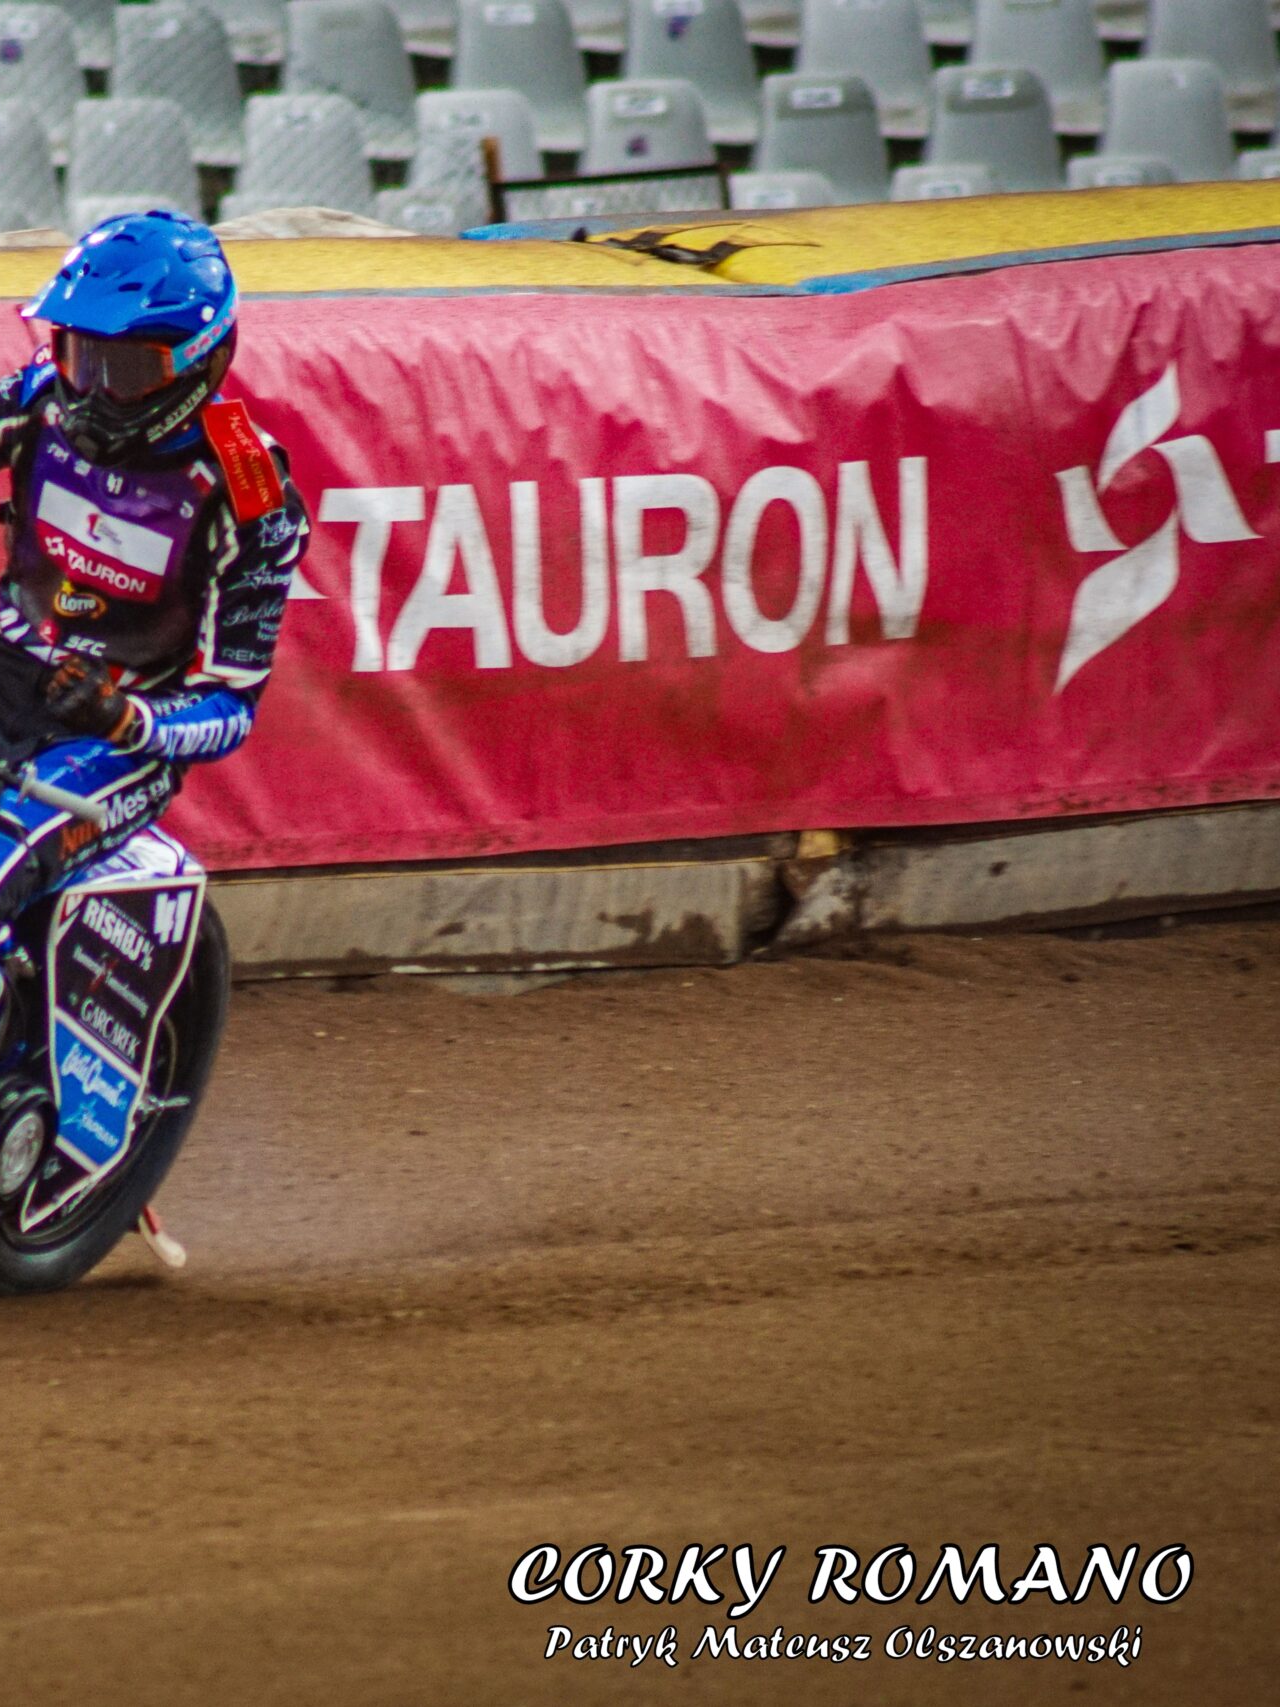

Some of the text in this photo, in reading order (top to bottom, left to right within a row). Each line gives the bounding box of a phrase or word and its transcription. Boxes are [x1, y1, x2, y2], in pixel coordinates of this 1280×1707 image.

[67, 549, 146, 593] TAURON
[319, 456, 929, 673] TAURON
[60, 594, 97, 613] LOTTO
[154, 890, 193, 944] 41
